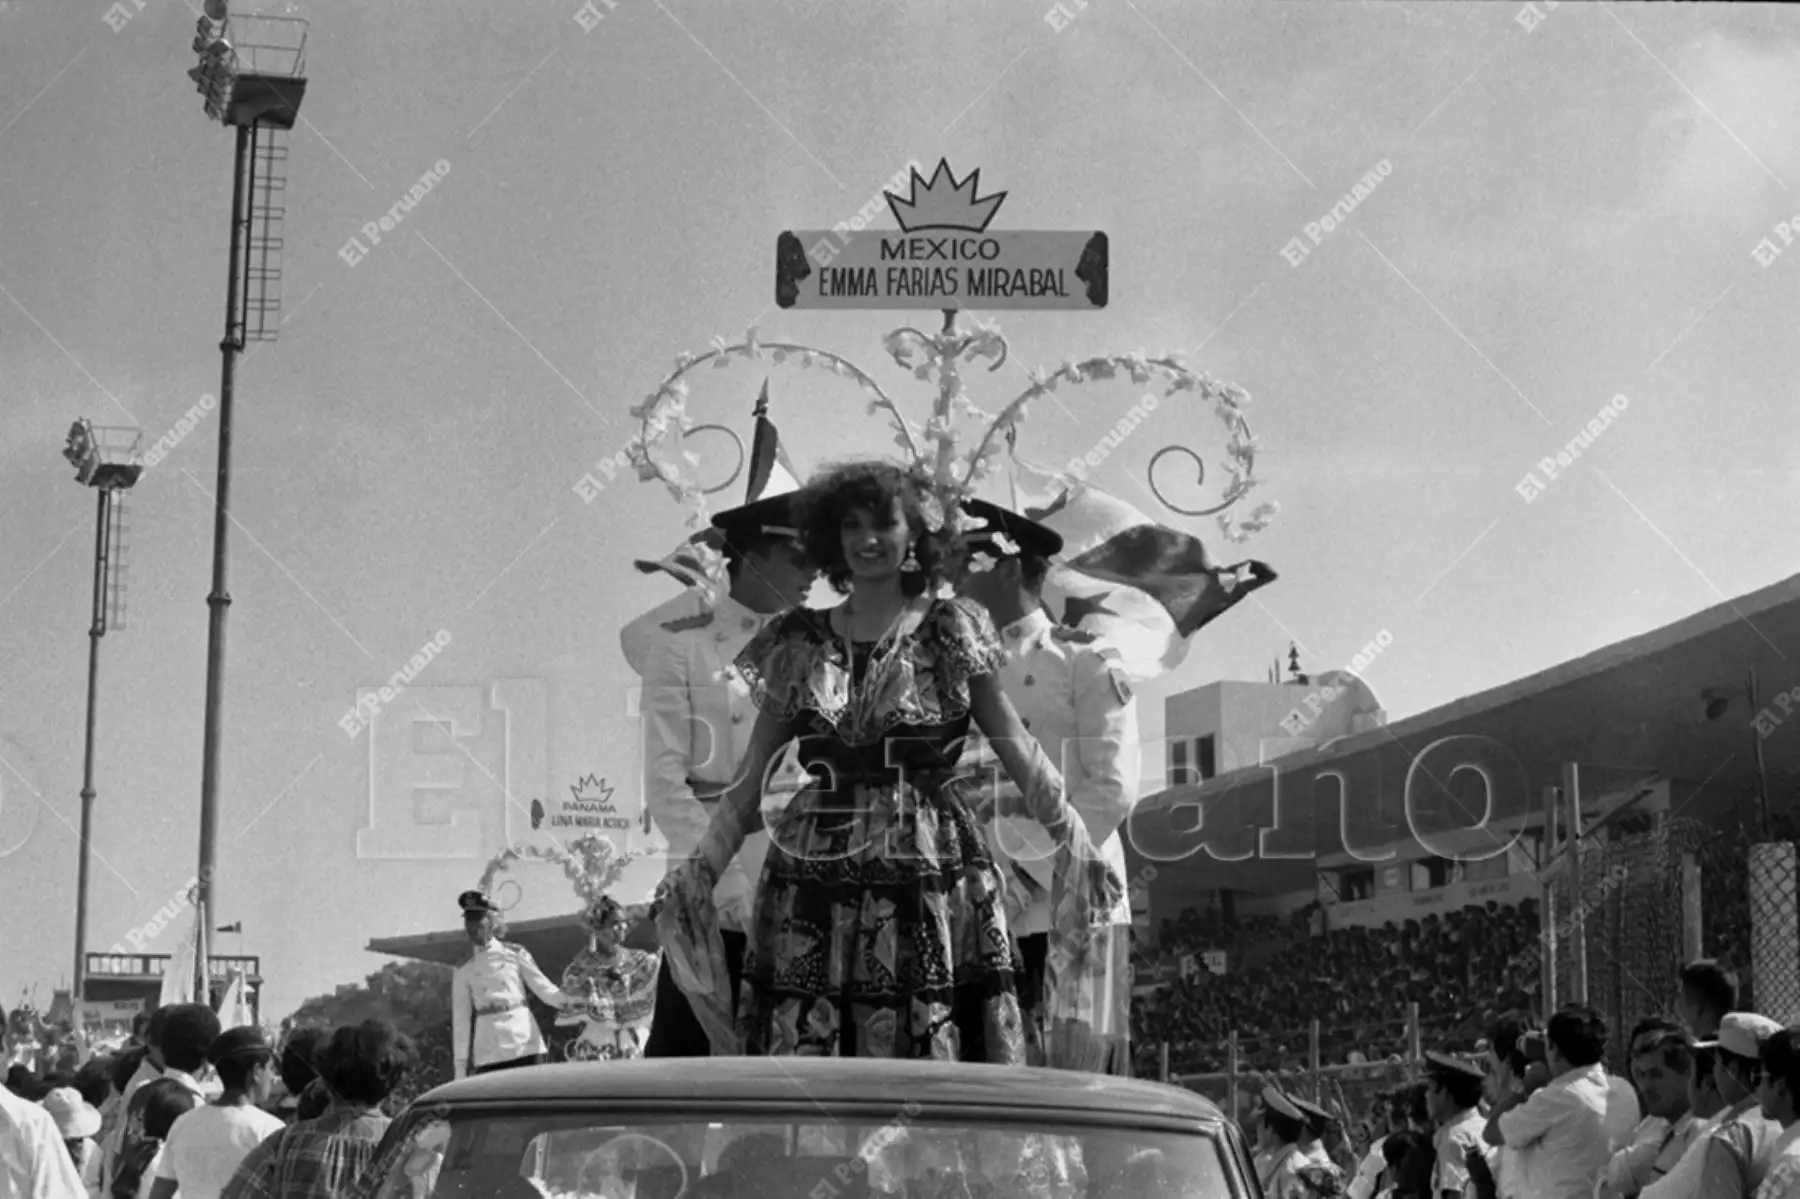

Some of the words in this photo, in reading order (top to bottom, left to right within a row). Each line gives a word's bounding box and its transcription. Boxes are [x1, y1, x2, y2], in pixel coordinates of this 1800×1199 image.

[880, 238, 1000, 260] MEXICO
[819, 267, 877, 297] EMMA
[886, 266, 958, 297] FARIAS
[967, 268, 1069, 298] MIRABAL
[562, 802, 617, 813] PANAMA
